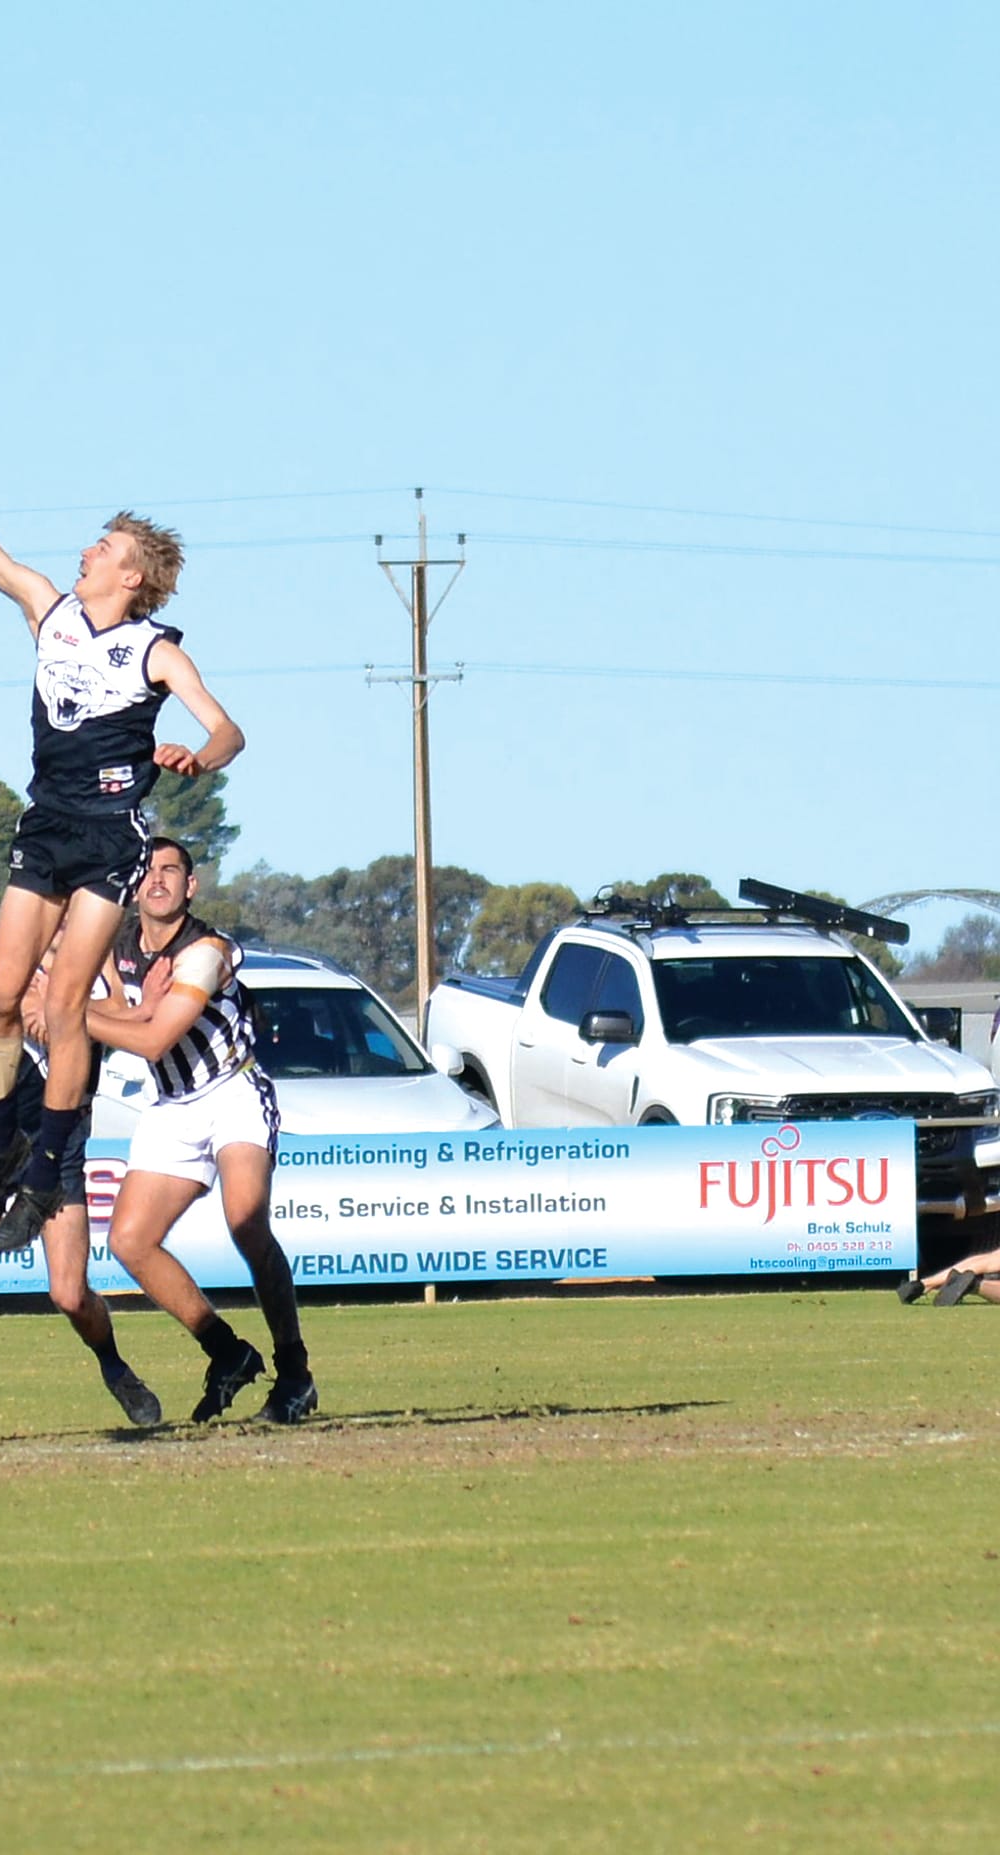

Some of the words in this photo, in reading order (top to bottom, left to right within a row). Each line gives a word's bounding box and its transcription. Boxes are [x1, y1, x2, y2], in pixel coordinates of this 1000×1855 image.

[278, 1144, 428, 1169] conditioning
[437, 1142, 455, 1162] &
[464, 1139, 630, 1166] Refrigeration
[699, 1157, 889, 1225] FUJITSU
[269, 1199, 330, 1222] ales,
[339, 1196, 430, 1218] Service
[439, 1195, 456, 1215] &
[466, 1192, 607, 1215] Installation
[807, 1223, 841, 1235] Brok
[846, 1221, 892, 1234] Schulz
[807, 1241, 839, 1251] 0405
[416, 1251, 487, 1273] WIDE
[496, 1248, 608, 1271] SERVICE
